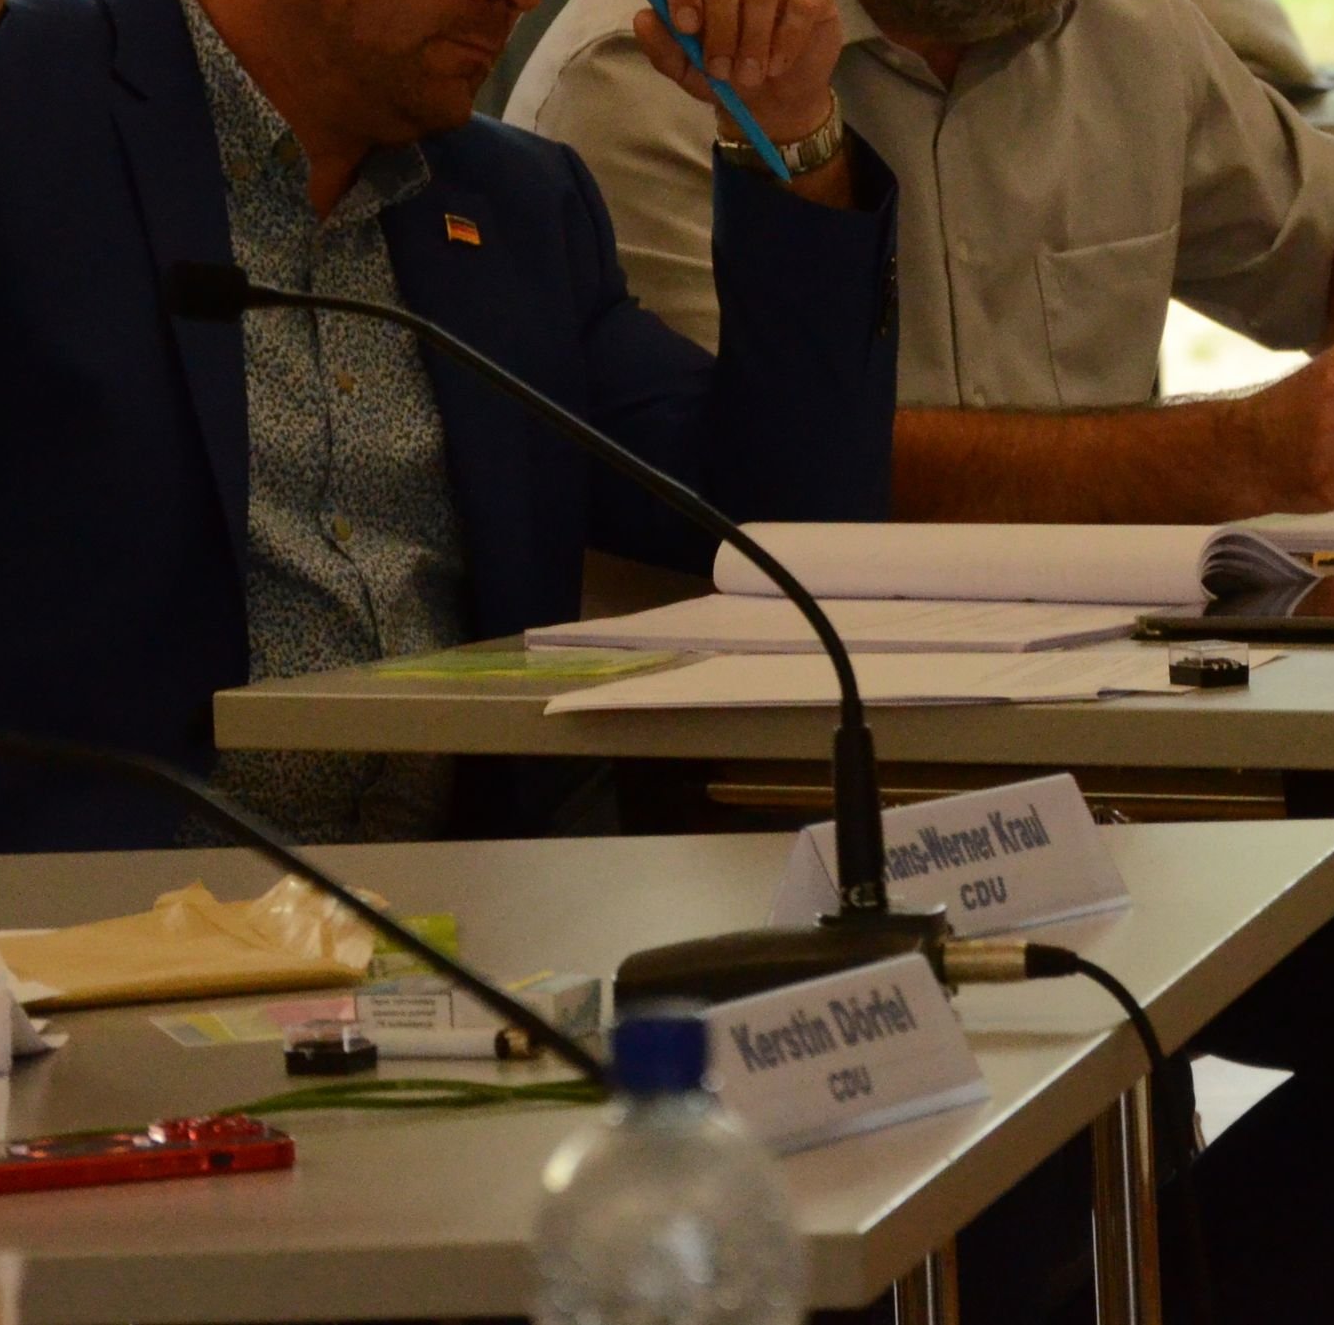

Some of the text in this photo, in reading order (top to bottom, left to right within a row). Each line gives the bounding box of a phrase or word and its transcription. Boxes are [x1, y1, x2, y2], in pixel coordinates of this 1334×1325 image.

[883, 804, 1051, 882] ans-Werner Kraul
[960, 875, 1007, 910] CDU
[730, 1009, 838, 1074] Kerstin
[828, 1065, 874, 1103] CDU
